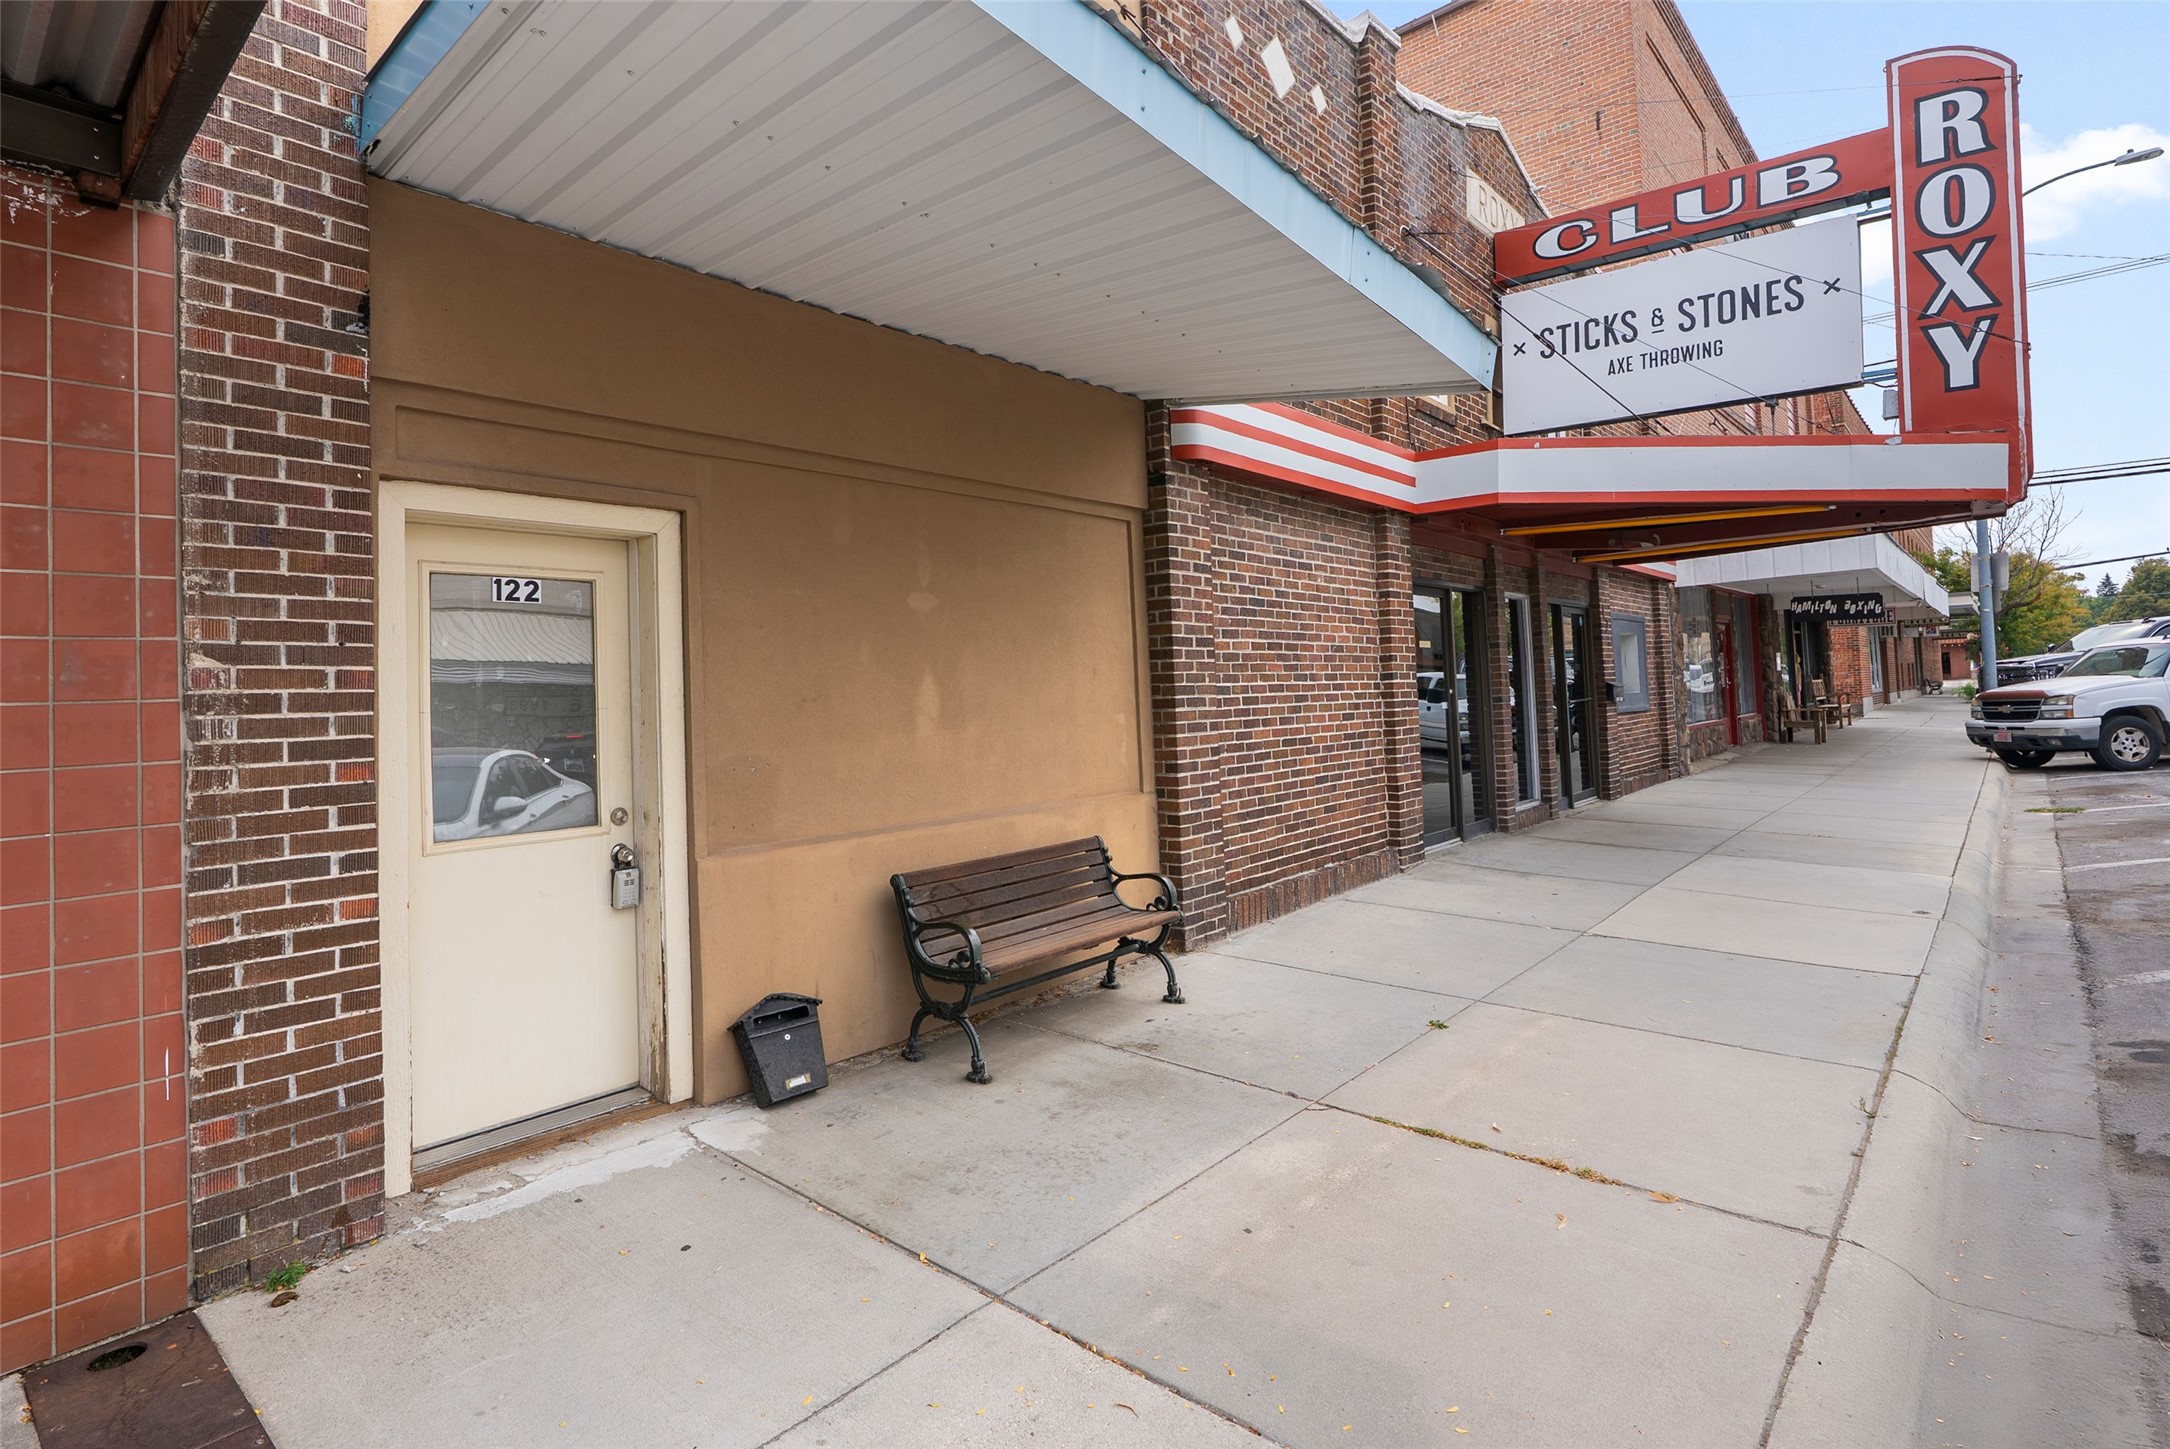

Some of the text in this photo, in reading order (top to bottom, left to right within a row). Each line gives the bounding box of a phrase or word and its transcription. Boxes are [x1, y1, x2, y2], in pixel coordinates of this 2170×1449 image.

[1533, 154, 1842, 260] CLUB
[1913, 86, 2003, 393] ROXY
[1539, 275, 1805, 359] STICKS & STONES
[1607, 339, 1724, 376] AXE THROWING
[493, 578, 540, 602] 122
[1791, 599, 1883, 615] HAMILTON BOXING
